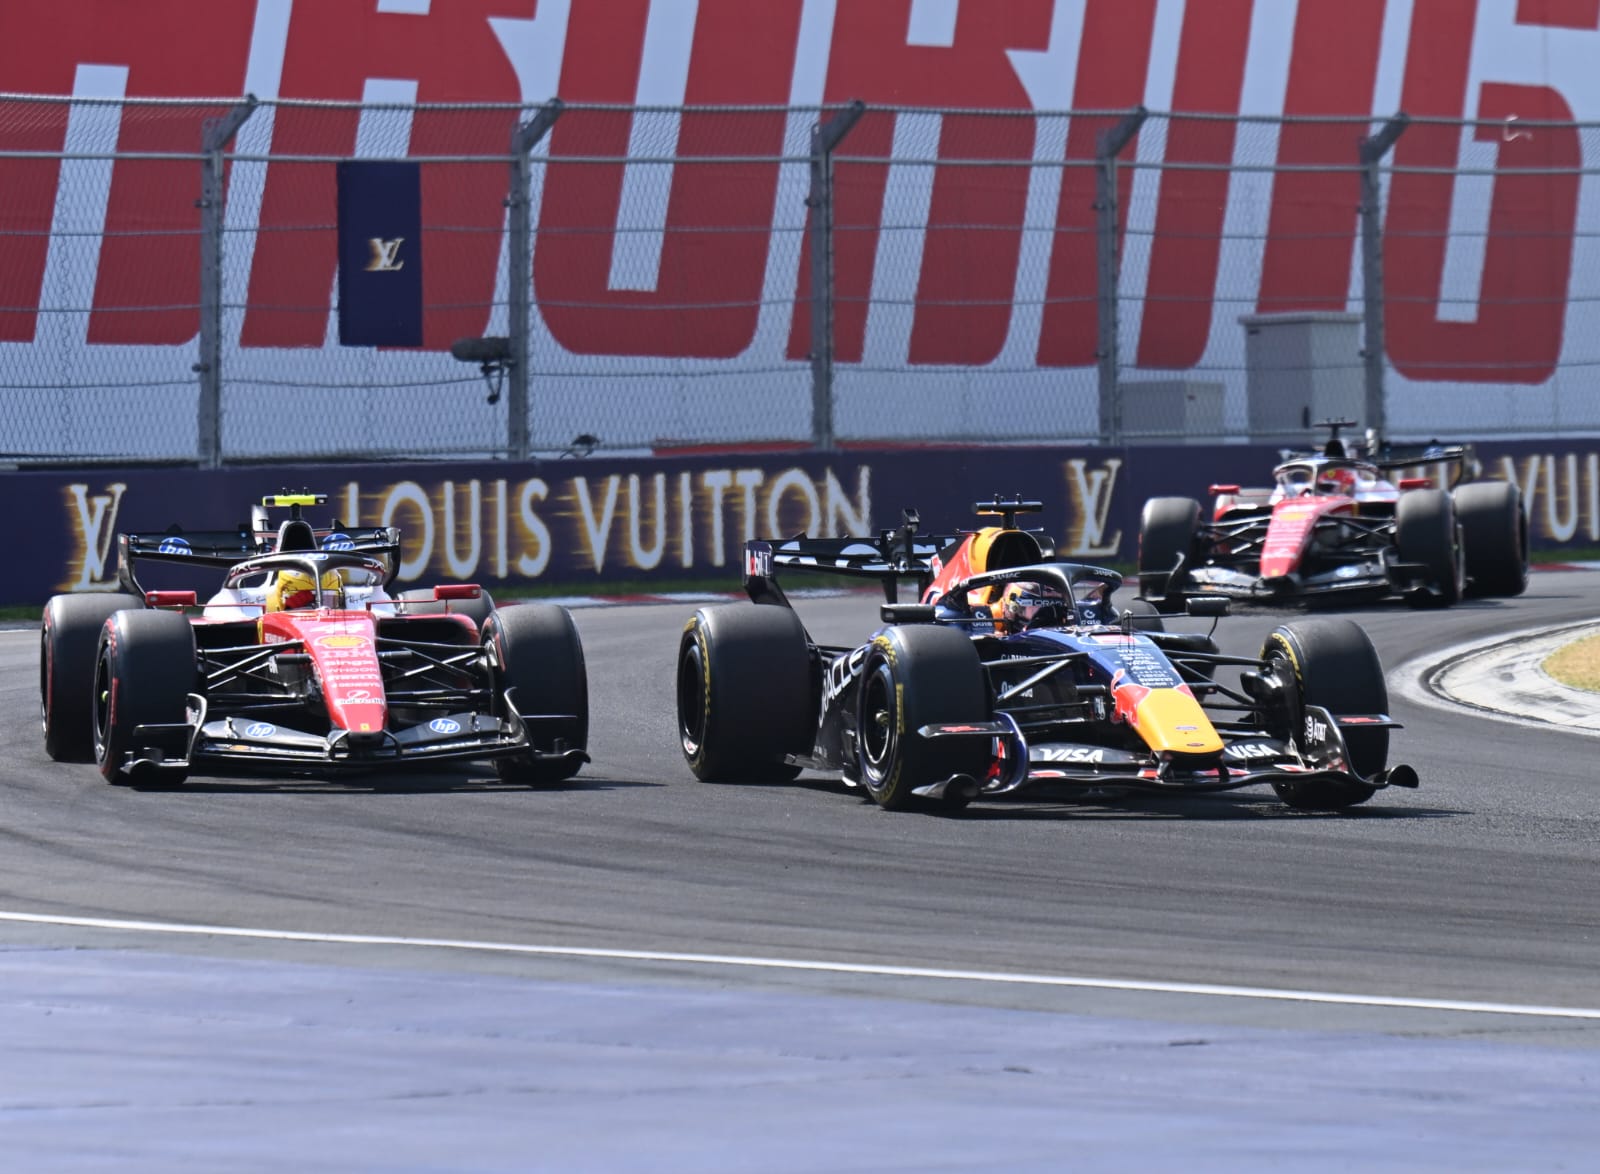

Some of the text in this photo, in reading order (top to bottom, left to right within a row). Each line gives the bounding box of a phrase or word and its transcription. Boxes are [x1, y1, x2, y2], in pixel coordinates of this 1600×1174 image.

[574, 465, 872, 575] VUITTON
[435, 719, 456, 733] hp
[1039, 748, 1103, 762] VISA
[1225, 744, 1281, 759] VISA
